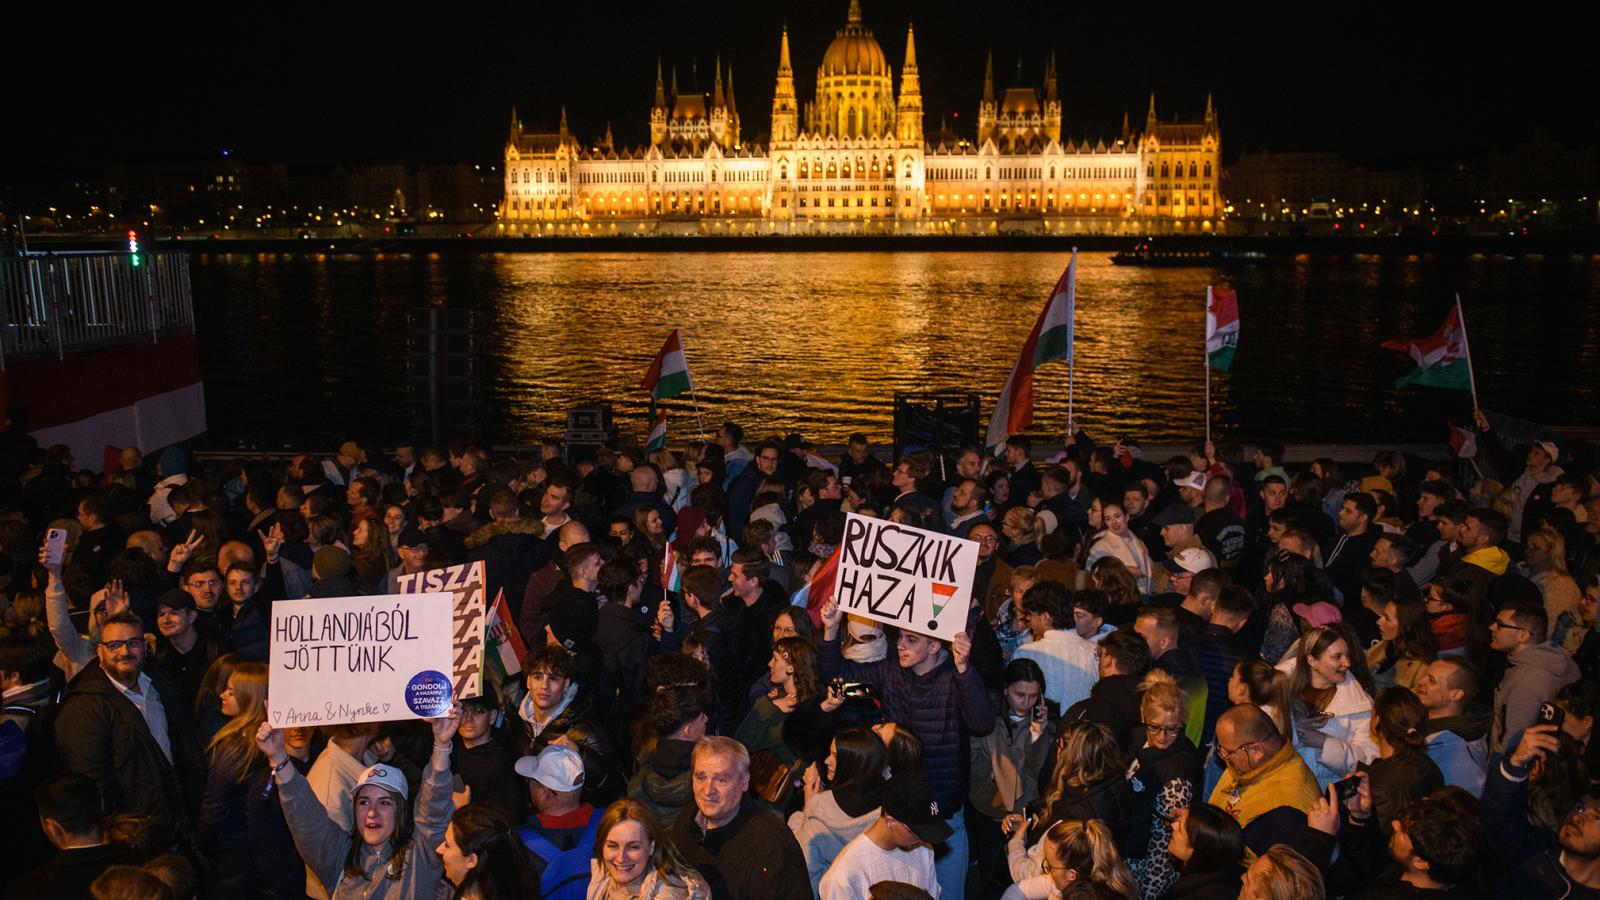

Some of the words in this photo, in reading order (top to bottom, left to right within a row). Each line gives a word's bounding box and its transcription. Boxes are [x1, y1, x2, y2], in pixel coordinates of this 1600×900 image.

[842, 518, 963, 583] RUSZKIK
[397, 560, 482, 594] TISZA
[276, 603, 419, 642] HOLLANDIÁBÓL
[284, 644, 395, 672] JÖTTÜNK
[411, 683, 447, 691] GONDOLJ
[413, 696, 445, 704] SZAVAZZ
[285, 707, 322, 724] Anna
[325, 701, 337, 720] &
[340, 702, 380, 722] Nynke
